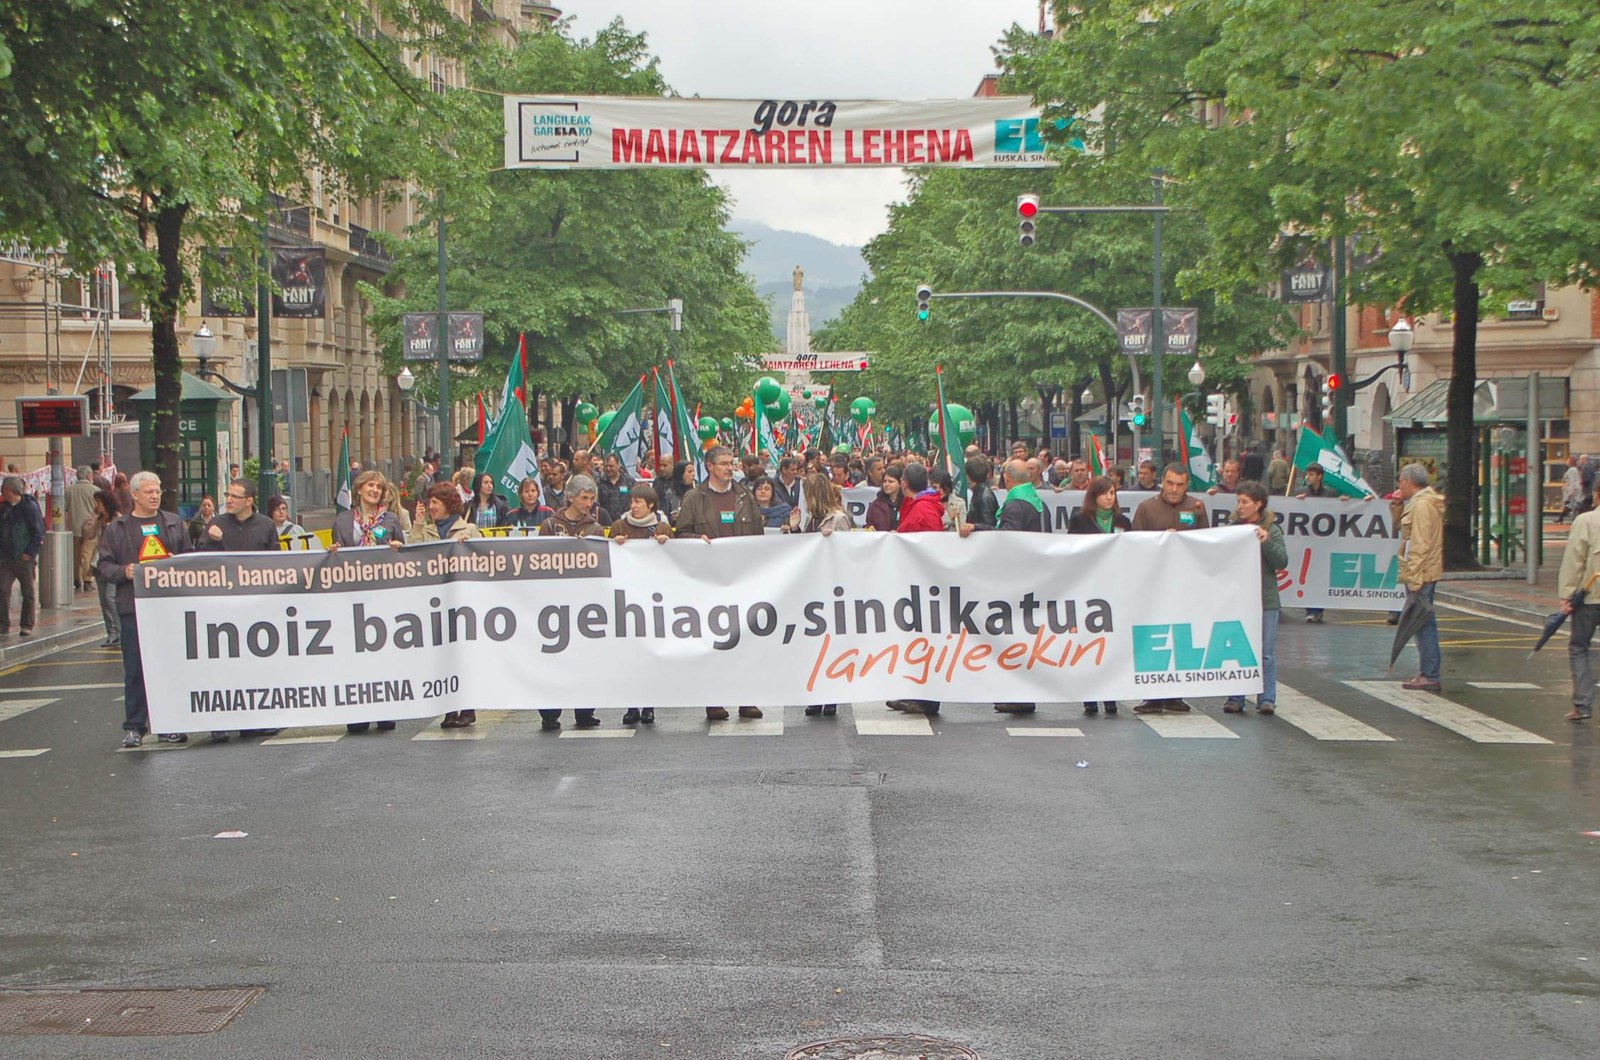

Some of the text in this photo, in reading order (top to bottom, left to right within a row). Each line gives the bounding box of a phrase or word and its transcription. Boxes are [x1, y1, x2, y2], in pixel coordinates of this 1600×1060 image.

[533, 115, 591, 126] LANGILEAK
[533, 126, 592, 137] GARELAKO
[750, 100, 837, 137] gora
[611, 128, 974, 164] MAIATZAREN LEHENA
[282, 286, 315, 303] FANT
[1291, 272, 1323, 290] FANT
[820, 361, 854, 369] LEHENA
[144, 550, 599, 590] Patronal, banca y gobiernos: chantaje y saqueo
[1328, 588, 1405, 599] EUSKAL SINDIKA
[184, 606, 334, 660] Inoiz
[353, 597, 517, 653] baino
[806, 624, 1106, 692] langileekin
[1132, 620, 1258, 672] ELA
[1134, 669, 1260, 684] EUSKAL SINDIKATUA
[190, 675, 459, 713] MAIATZAREN LEHENA 2010
